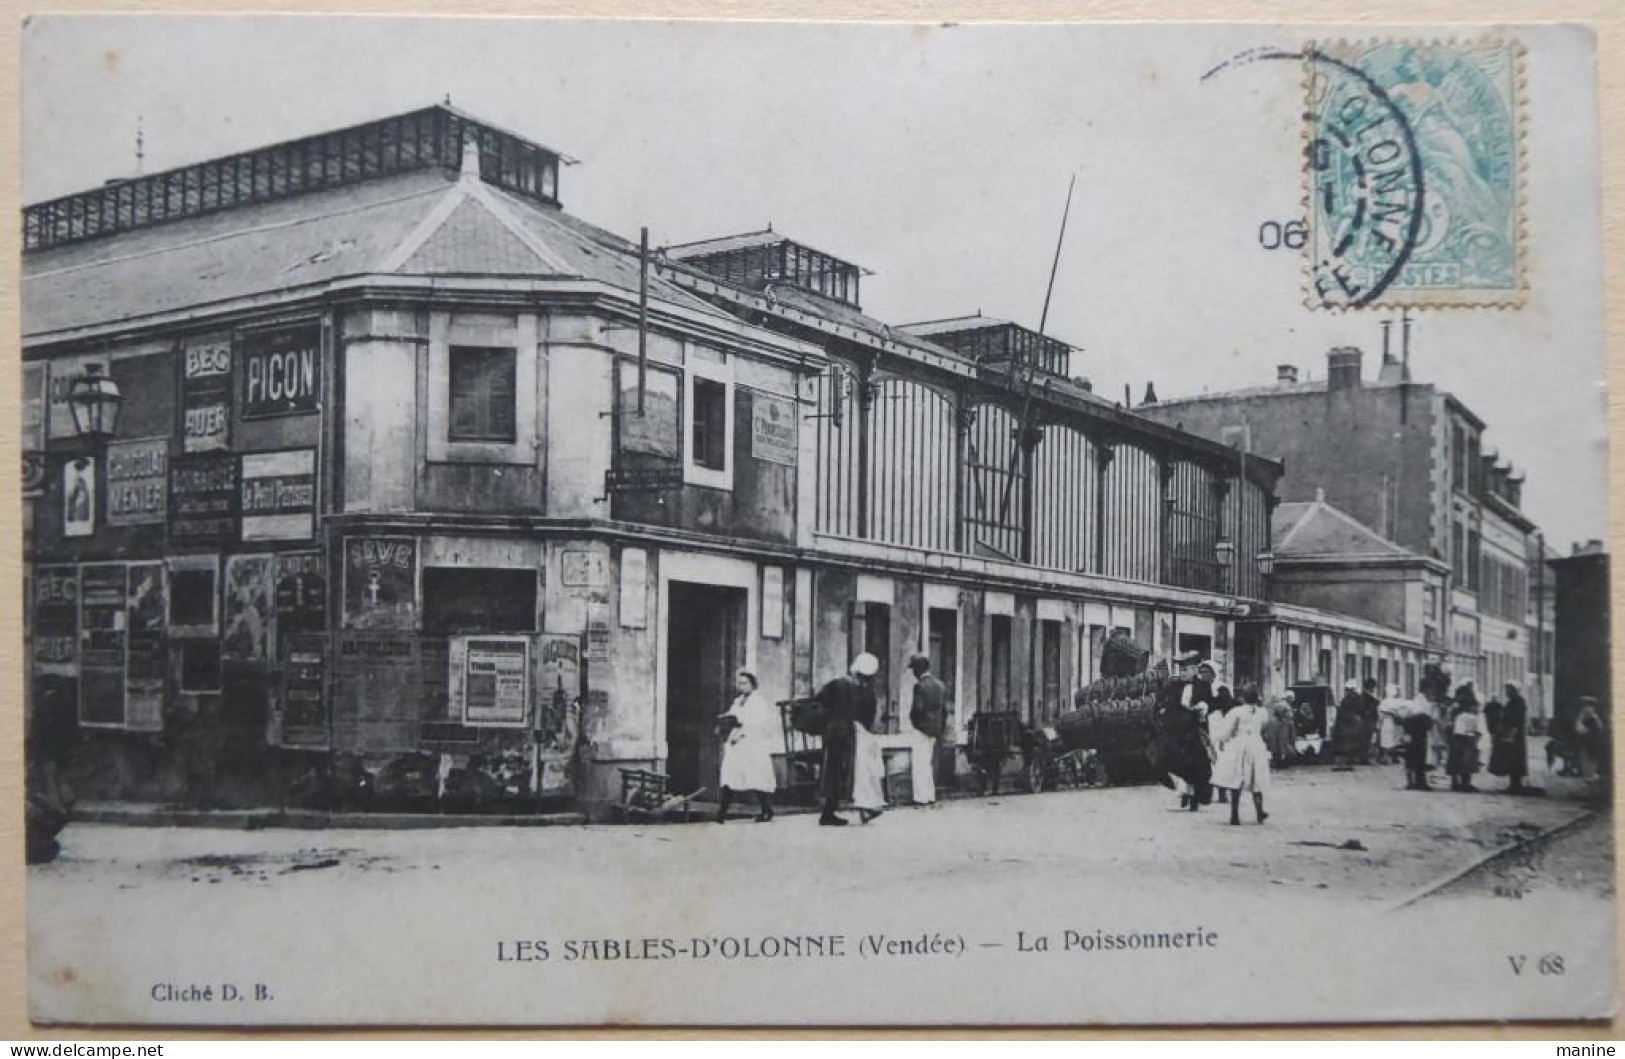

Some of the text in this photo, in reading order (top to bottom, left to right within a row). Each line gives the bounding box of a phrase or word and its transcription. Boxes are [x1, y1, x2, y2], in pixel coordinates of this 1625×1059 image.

[1259, 220, 1309, 250] 06
[185, 347, 230, 376] BEC
[249, 350, 315, 403] PICON
